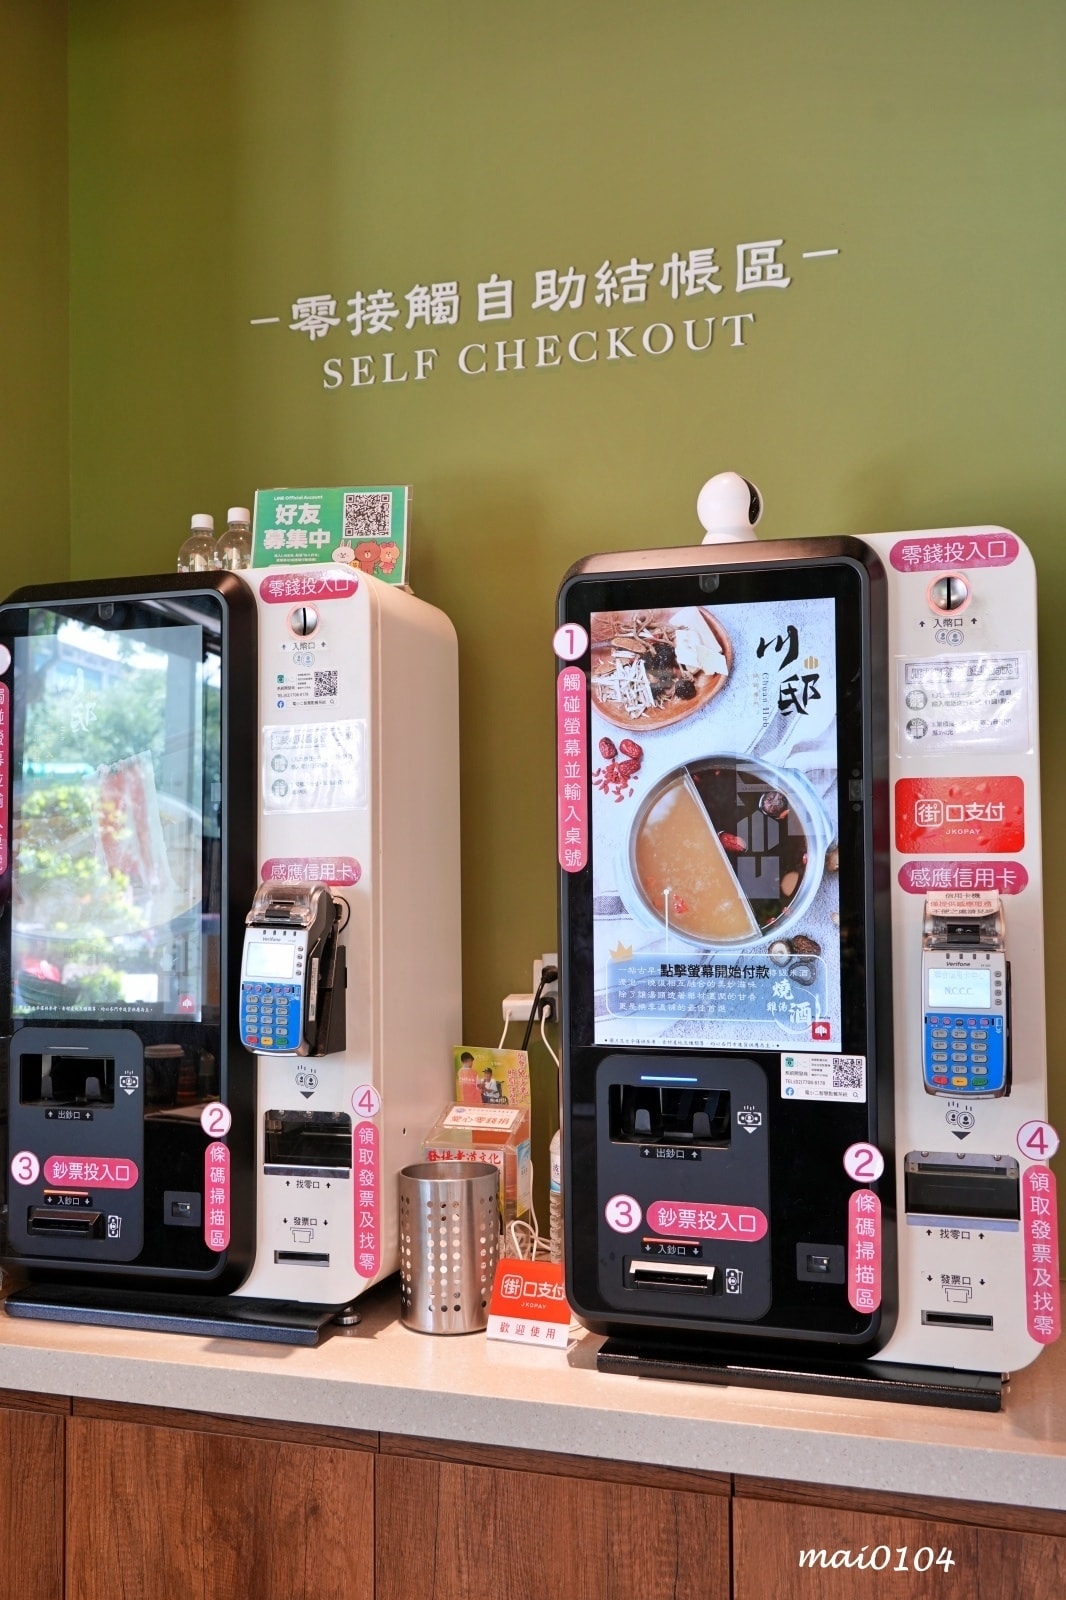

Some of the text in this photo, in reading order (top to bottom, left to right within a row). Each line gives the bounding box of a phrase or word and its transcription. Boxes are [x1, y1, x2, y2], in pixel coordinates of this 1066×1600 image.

[288, 239, 791, 341] 零接觸自助結帳區
[322, 312, 756, 390] SELF CHECKOUT
[275, 503, 321, 526] 好友
[263, 528, 330, 550] 募集中
[902, 541, 1006, 565] 零錢投入口
[268, 578, 349, 597] 零錢投入口
[933, 618, 963, 628] 入幣口
[564, 629, 574, 655] 1
[762, 707, 770, 728] Hub
[563, 674, 582, 867] 觸碰螢幕並輸入桌號
[916, 800, 1005, 825] 街口支付
[271, 863, 353, 881] 感應信用卡
[910, 868, 1017, 888] 感應信用卡
[660, 963, 770, 979] 點擊螢幕開始付款
[358, 1089, 374, 1112] 4
[57, 1109, 81, 1120] 出鈔口
[209, 1107, 225, 1133] 2
[1026, 1126, 1049, 1155] 4
[656, 1148, 685, 1159] 出鈔口
[854, 1148, 875, 1178] 2
[18, 1156, 33, 1180] 3
[53, 1161, 130, 1182] 鈔票投入口
[209, 1145, 226, 1247] 條碼掃描區
[296, 1180, 320, 1189] 找零口
[57, 1196, 80, 1206] 入鈔口
[358, 1127, 375, 1271] 領取發票及找零
[293, 1216, 318, 1226] 發票口
[614, 1200, 633, 1228] 3
[658, 1207, 756, 1233] 鈔票投入口
[939, 1229, 971, 1240] 找零口
[657, 1244, 686, 1256] 入鈔口
[855, 1193, 876, 1308] 條碼掃描區
[1028, 1172, 1055, 1336] 領取發票及找零
[503, 1276, 564, 1300] 街口支付
[940, 1274, 971, 1285] 發票口
[499, 1321, 556, 1339] 歡迎使用
